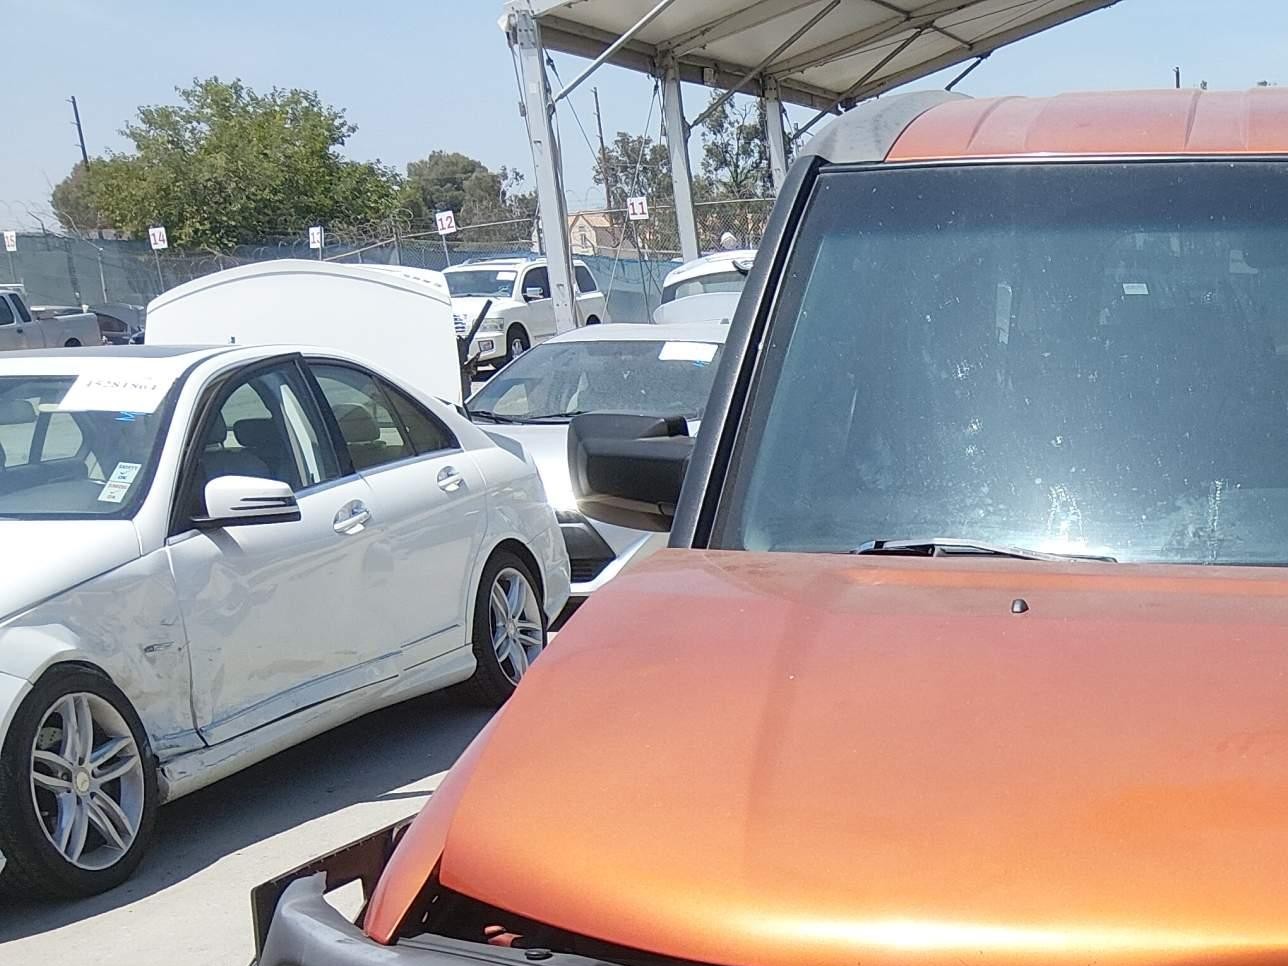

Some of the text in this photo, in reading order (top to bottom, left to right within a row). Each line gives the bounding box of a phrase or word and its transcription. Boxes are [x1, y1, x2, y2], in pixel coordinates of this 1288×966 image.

[629, 201, 648, 216] 11
[438, 215, 455, 231] 12
[151, 231, 166, 246] 14
